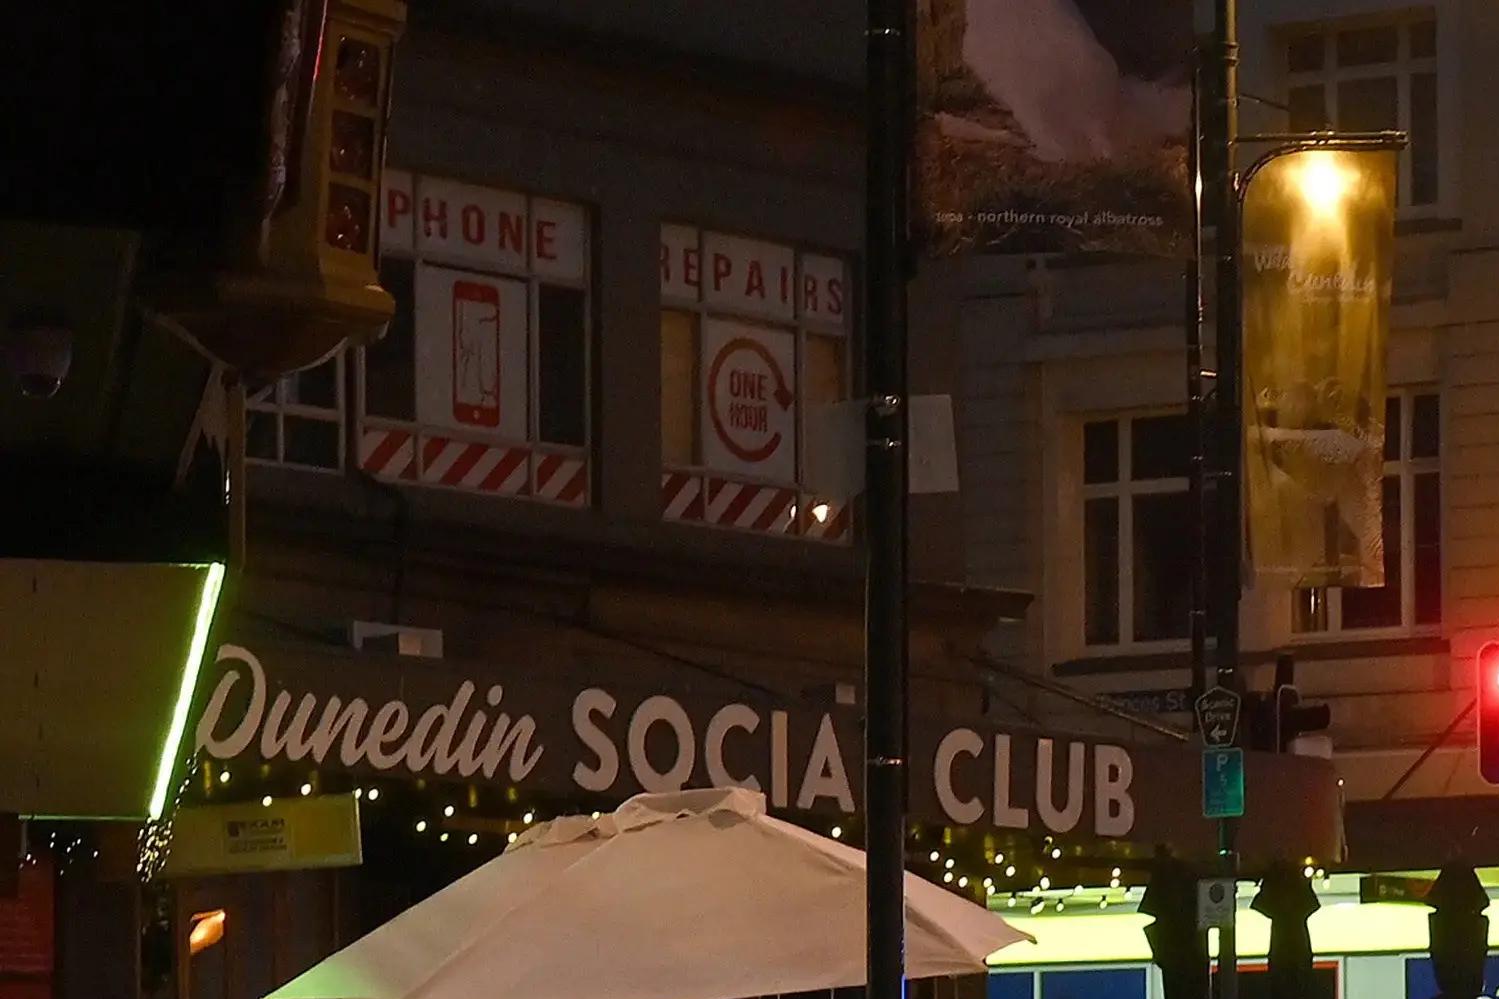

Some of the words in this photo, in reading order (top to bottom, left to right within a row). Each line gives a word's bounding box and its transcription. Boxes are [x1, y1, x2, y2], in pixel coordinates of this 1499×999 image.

[387, 188, 557, 261] PHONE
[977, 207, 1045, 223] northern
[1049, 210, 1089, 228] royal
[1092, 209, 1164, 226] albatross
[730, 370, 767, 401] ONE
[730, 402, 768, 433] HOUR
[196, 643, 543, 782] Dunedin
[571, 687, 856, 812] SOCIA
[933, 728, 1136, 837] CLUB
